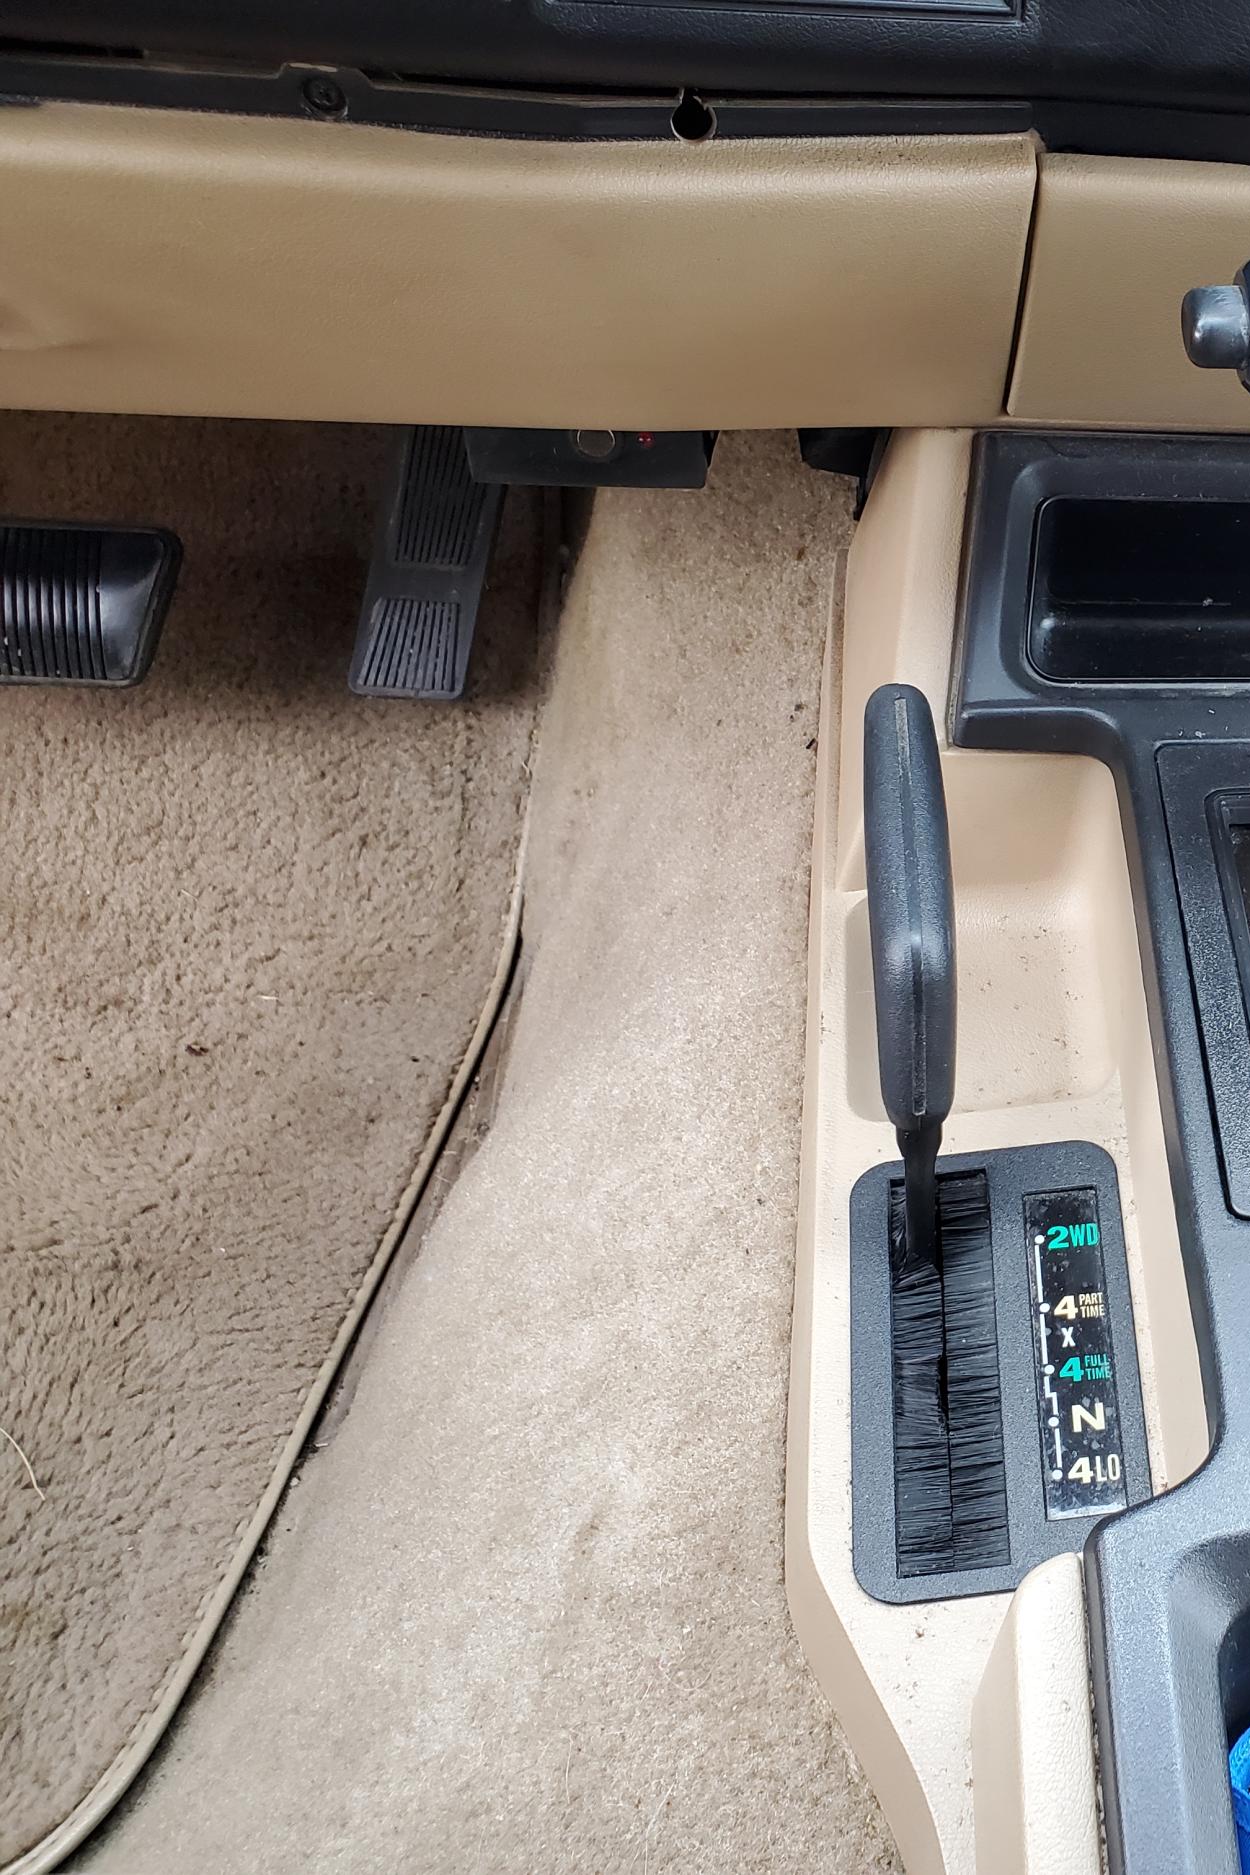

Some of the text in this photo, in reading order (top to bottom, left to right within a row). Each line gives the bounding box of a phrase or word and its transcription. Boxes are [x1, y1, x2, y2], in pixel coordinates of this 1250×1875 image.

[1047, 1222, 1099, 1250] 2WD
[1053, 1295, 1078, 1320] 4
[1078, 1291, 1104, 1306] PART
[1080, 1304, 1105, 1319] TIME
[1059, 1356, 1084, 1382] 4
[1084, 1354, 1110, 1368] FULL
[1085, 1366, 1111, 1380] TIME
[1071, 1402, 1106, 1433] N
